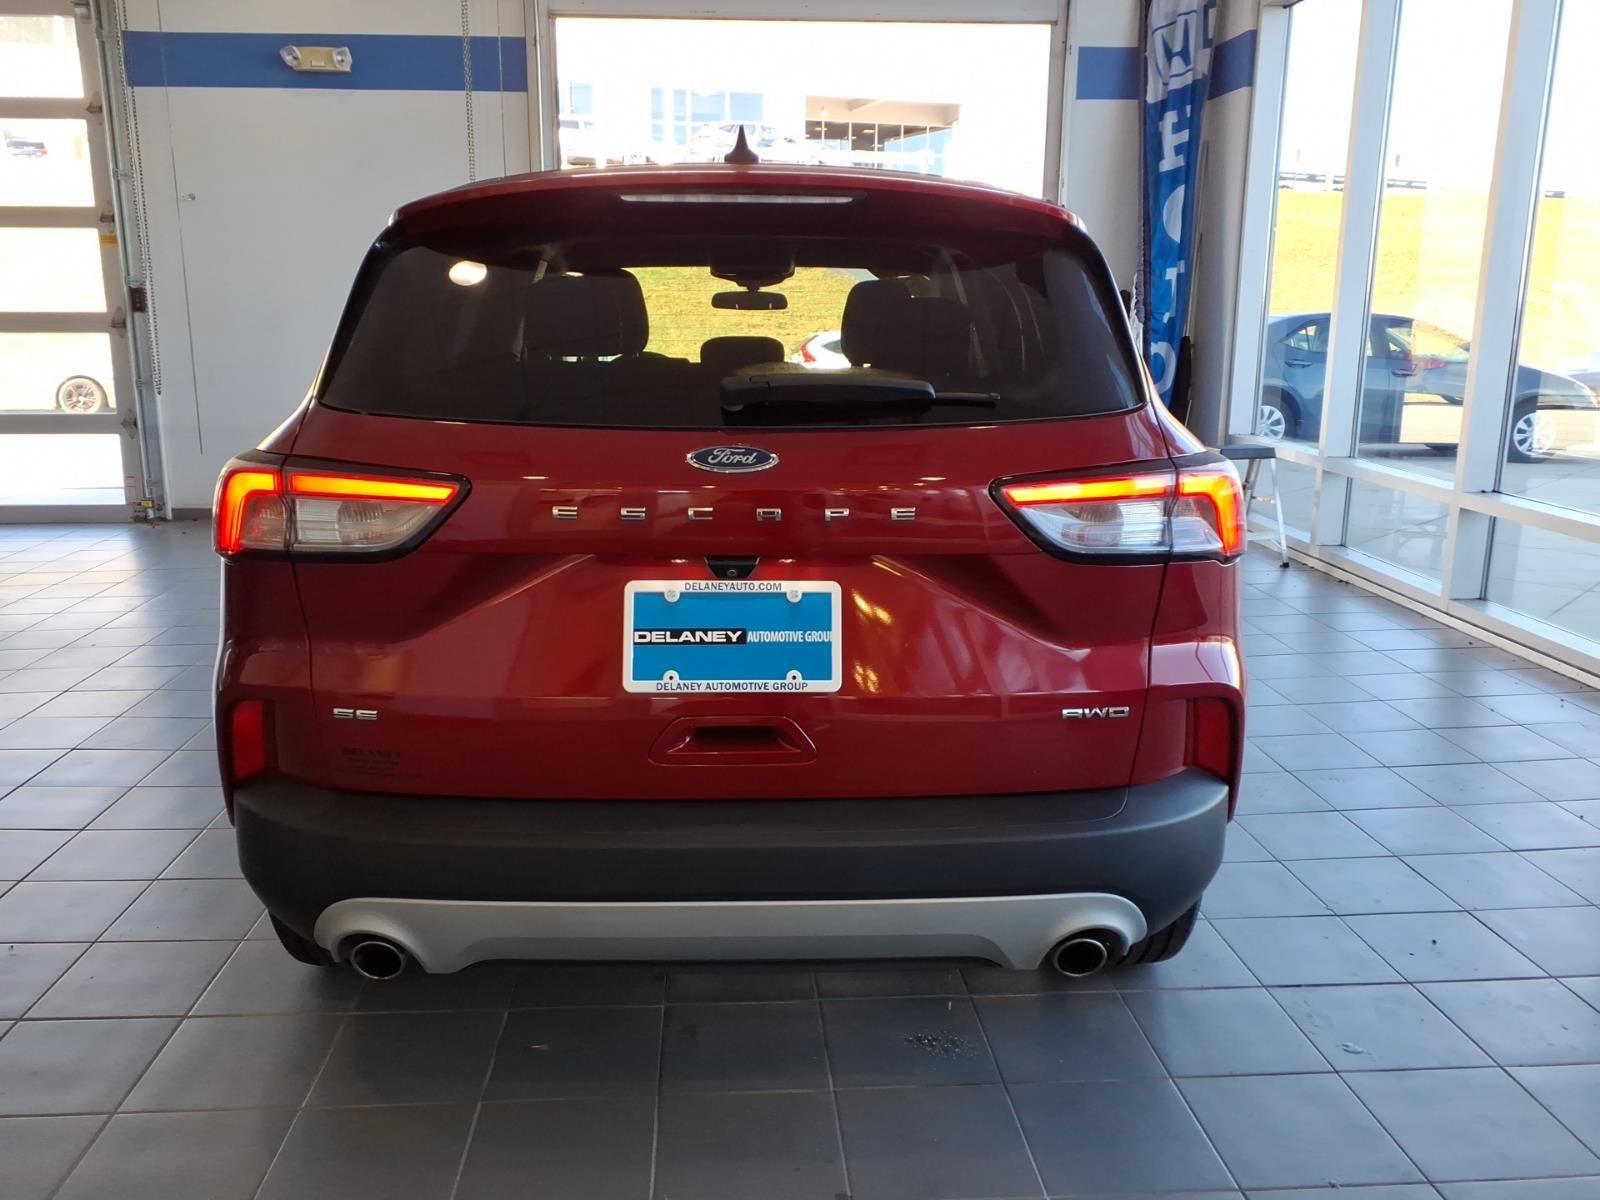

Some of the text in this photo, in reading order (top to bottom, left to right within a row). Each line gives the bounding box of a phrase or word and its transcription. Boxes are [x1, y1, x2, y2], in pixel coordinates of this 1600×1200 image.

[707, 447, 757, 465] Ford
[552, 505, 917, 521] ESCAPE
[684, 582, 782, 592] DELANEYAUTO.COM
[634, 630, 743, 643] DELANEY
[747, 630, 804, 643] AUTOMOTIVE
[656, 682, 808, 691] DELANEY AUTOMOTIVE GROUP
[333, 707, 378, 720] SE
[1062, 706, 1130, 719] AWD
